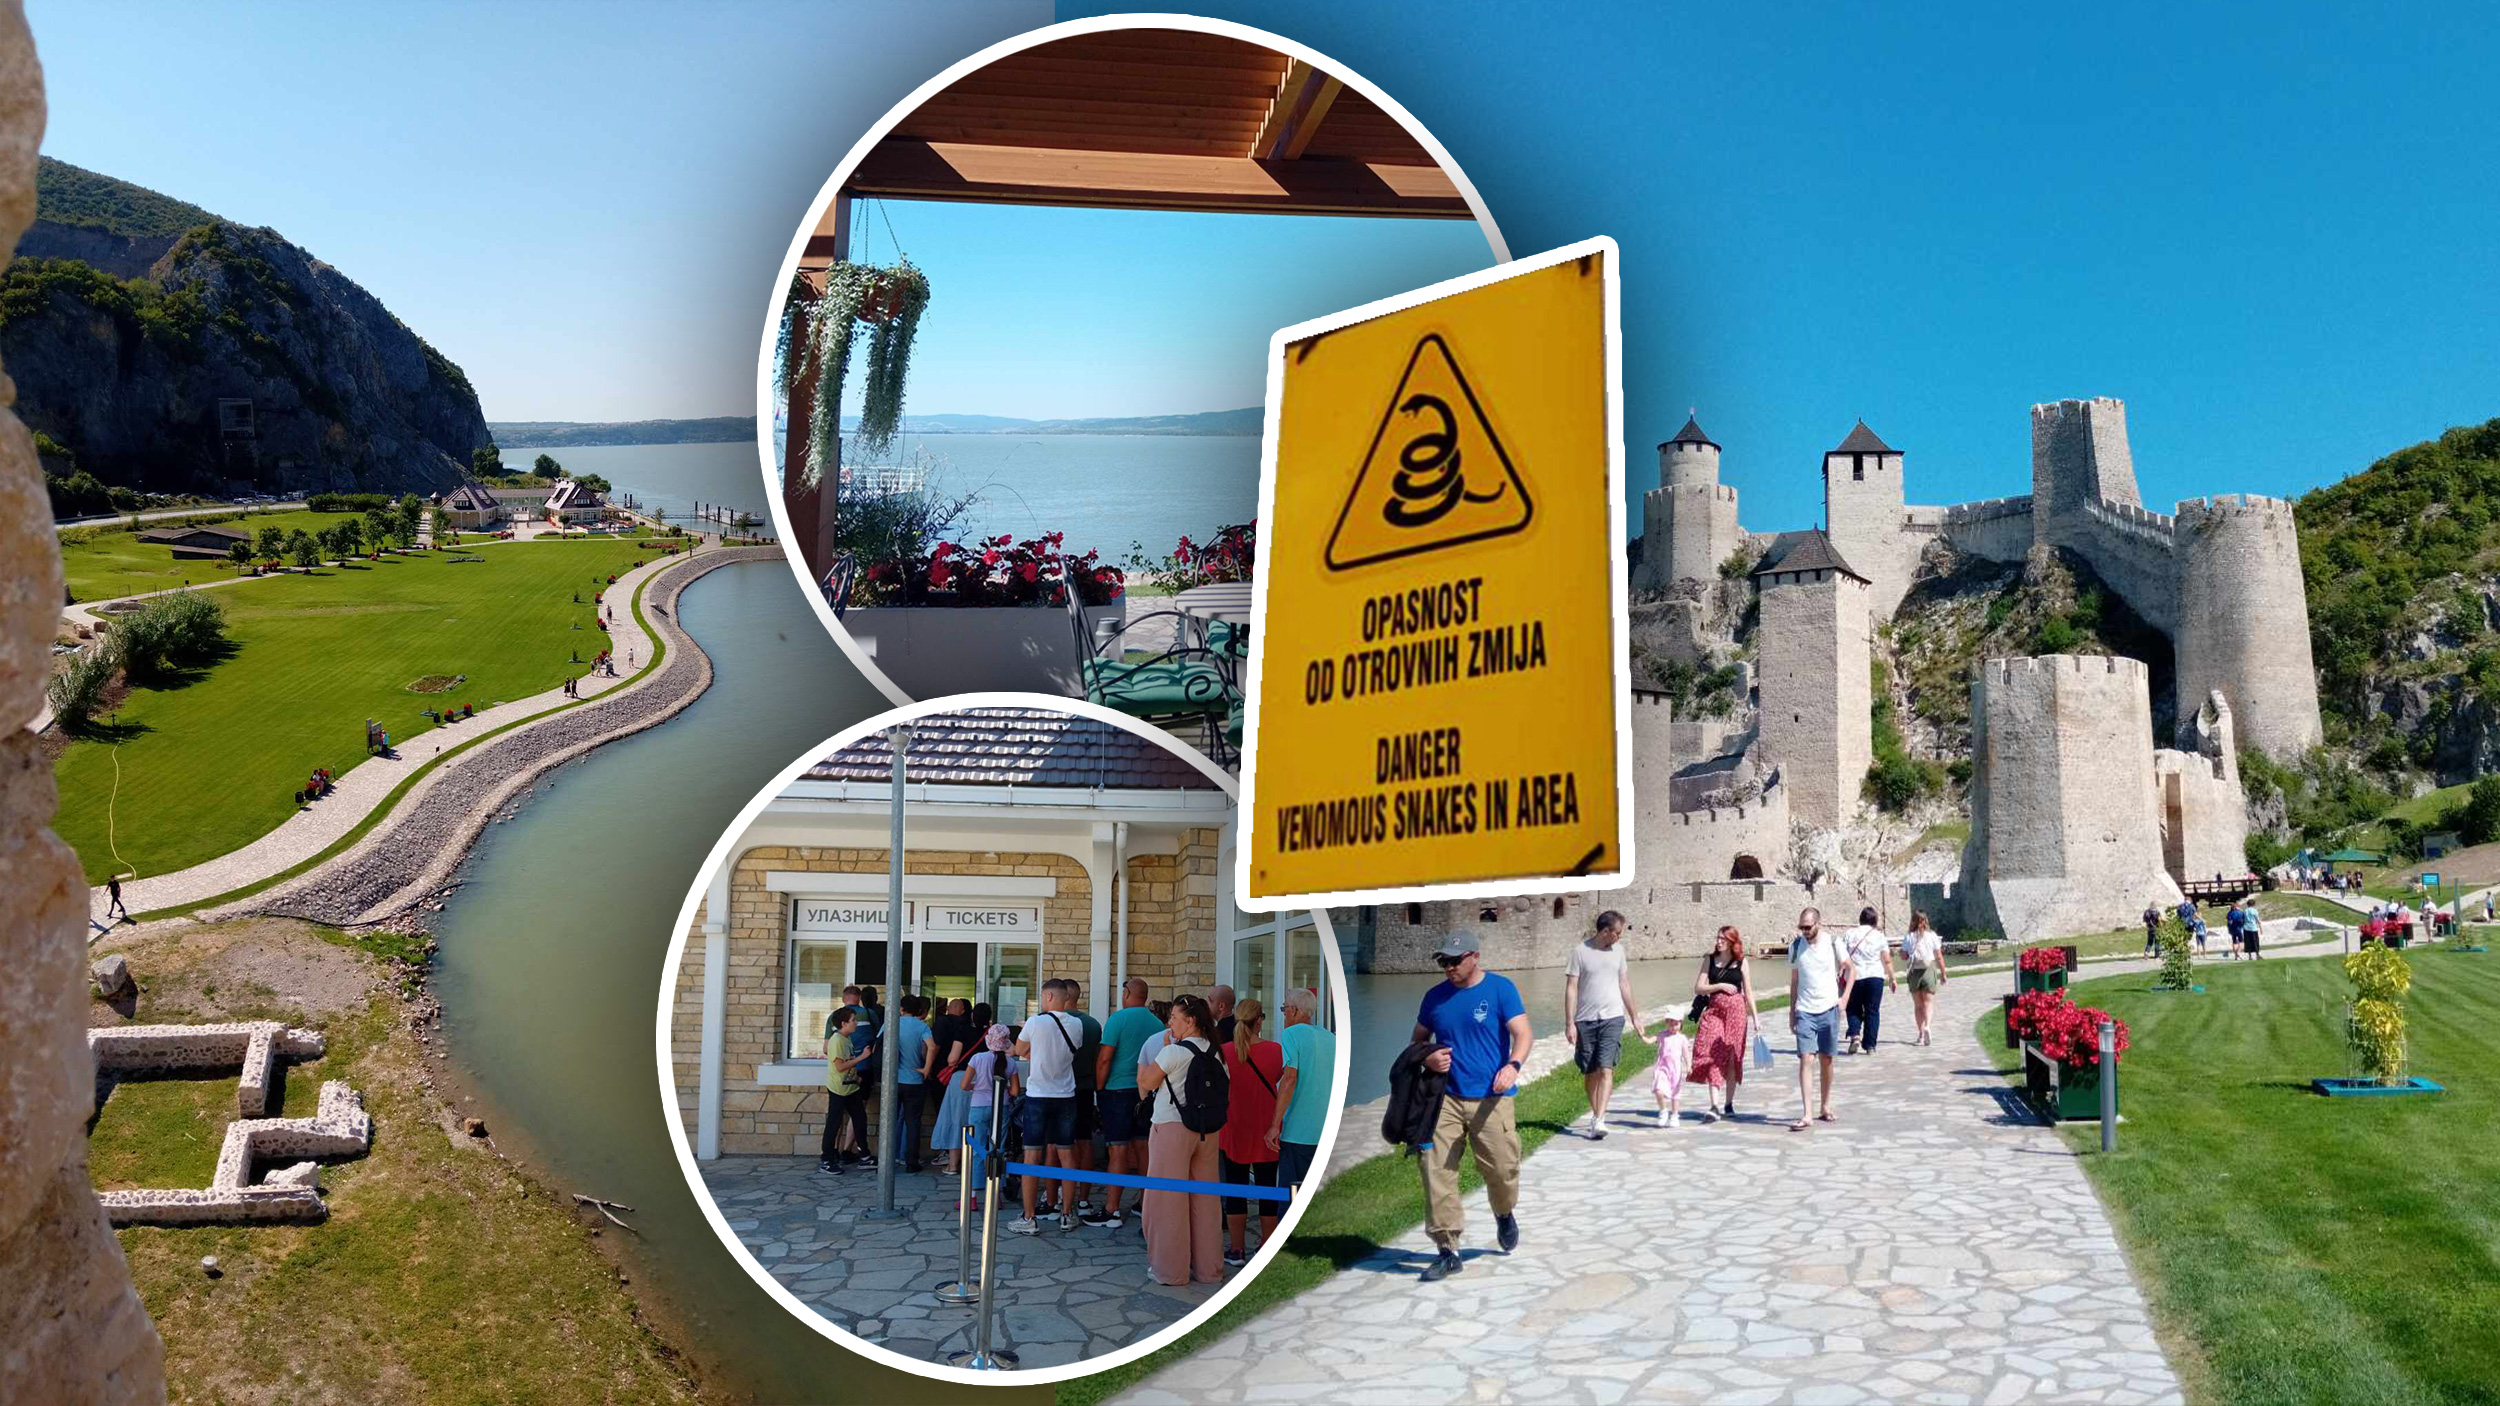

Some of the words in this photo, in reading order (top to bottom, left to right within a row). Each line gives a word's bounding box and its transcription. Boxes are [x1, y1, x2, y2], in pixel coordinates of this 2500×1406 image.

[1363, 577, 1482, 642] OPASNOST
[1306, 658, 1334, 706] OD
[1342, 635, 1458, 699] OTROVNIH
[1467, 620, 1546, 678] ZMIJA
[1376, 727, 1461, 784] DANGER
[1278, 794, 1386, 853] VENOMOUS
[1394, 782, 1477, 840] SNAKES
[1485, 779, 1508, 831] IN
[1517, 772, 1579, 828] AREA
[807, 908, 889, 924] УЛАЗНИЦ
[946, 911, 1018, 926] TICKETS
